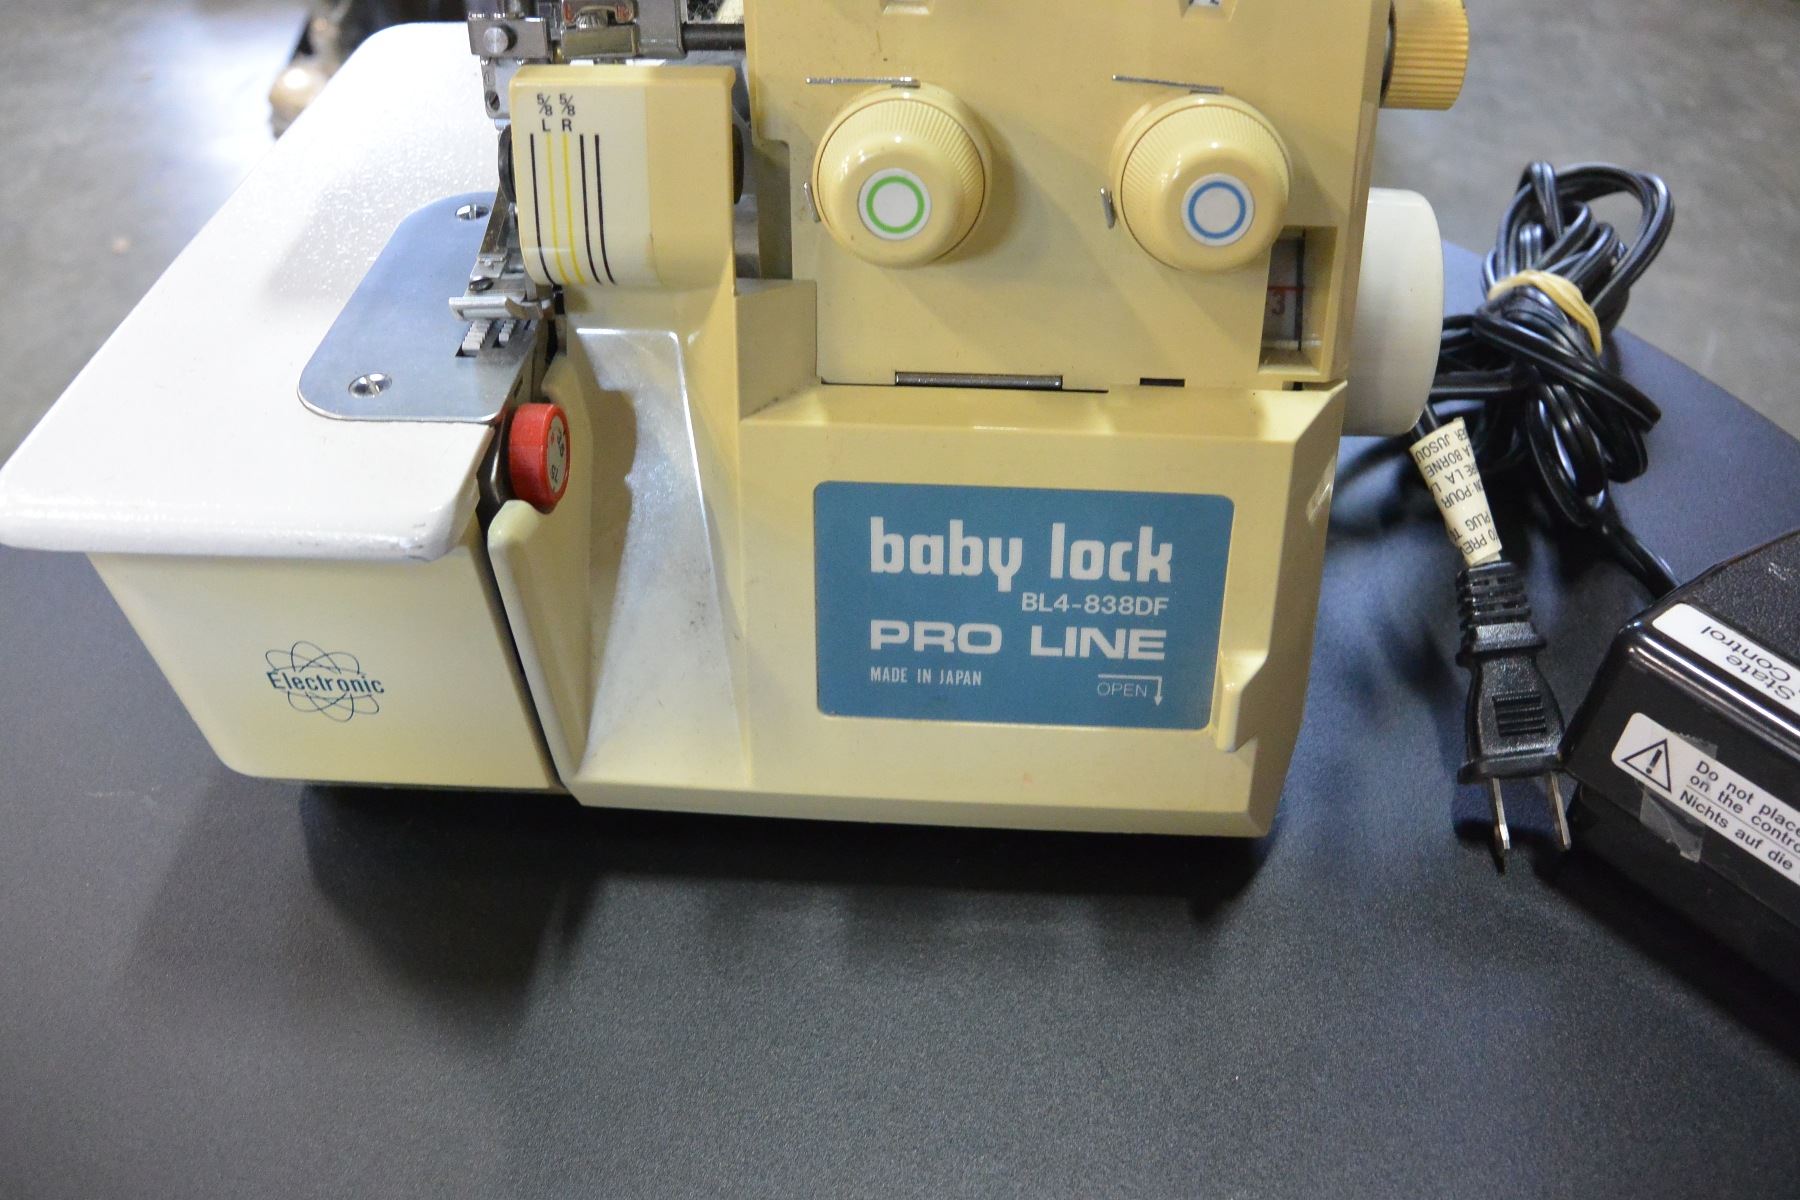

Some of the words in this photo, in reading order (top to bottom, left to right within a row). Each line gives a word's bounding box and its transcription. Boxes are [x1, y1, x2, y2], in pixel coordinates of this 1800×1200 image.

[542, 119, 551, 132] L
[562, 119, 572, 132] R
[1425, 450, 1463, 478] BORNE
[1445, 471, 1464, 484] LA
[1441, 486, 1472, 508] POUR
[870, 516, 1022, 592] baby
[1050, 523, 1172, 583] lock
[1022, 592, 1169, 616] BL4-838DF
[870, 620, 1002, 655] PRO
[1031, 625, 1167, 661] LINE
[1701, 626, 1791, 682] Control
[267, 672, 384, 693] Electronic
[870, 667, 908, 683] MADE
[917, 668, 932, 684] IN
[940, 670, 982, 686] JAPAN
[1097, 682, 1147, 698] OPEN
[1726, 654, 1796, 701] State
[1690, 775, 1710, 793] on
[1717, 791, 1743, 814] the
[1696, 761, 1719, 782] Do
[1726, 782, 1755, 805] not
[1680, 790, 1729, 828] Nichts
[1734, 828, 1764, 850] auf
[1768, 850, 1793, 870] die
